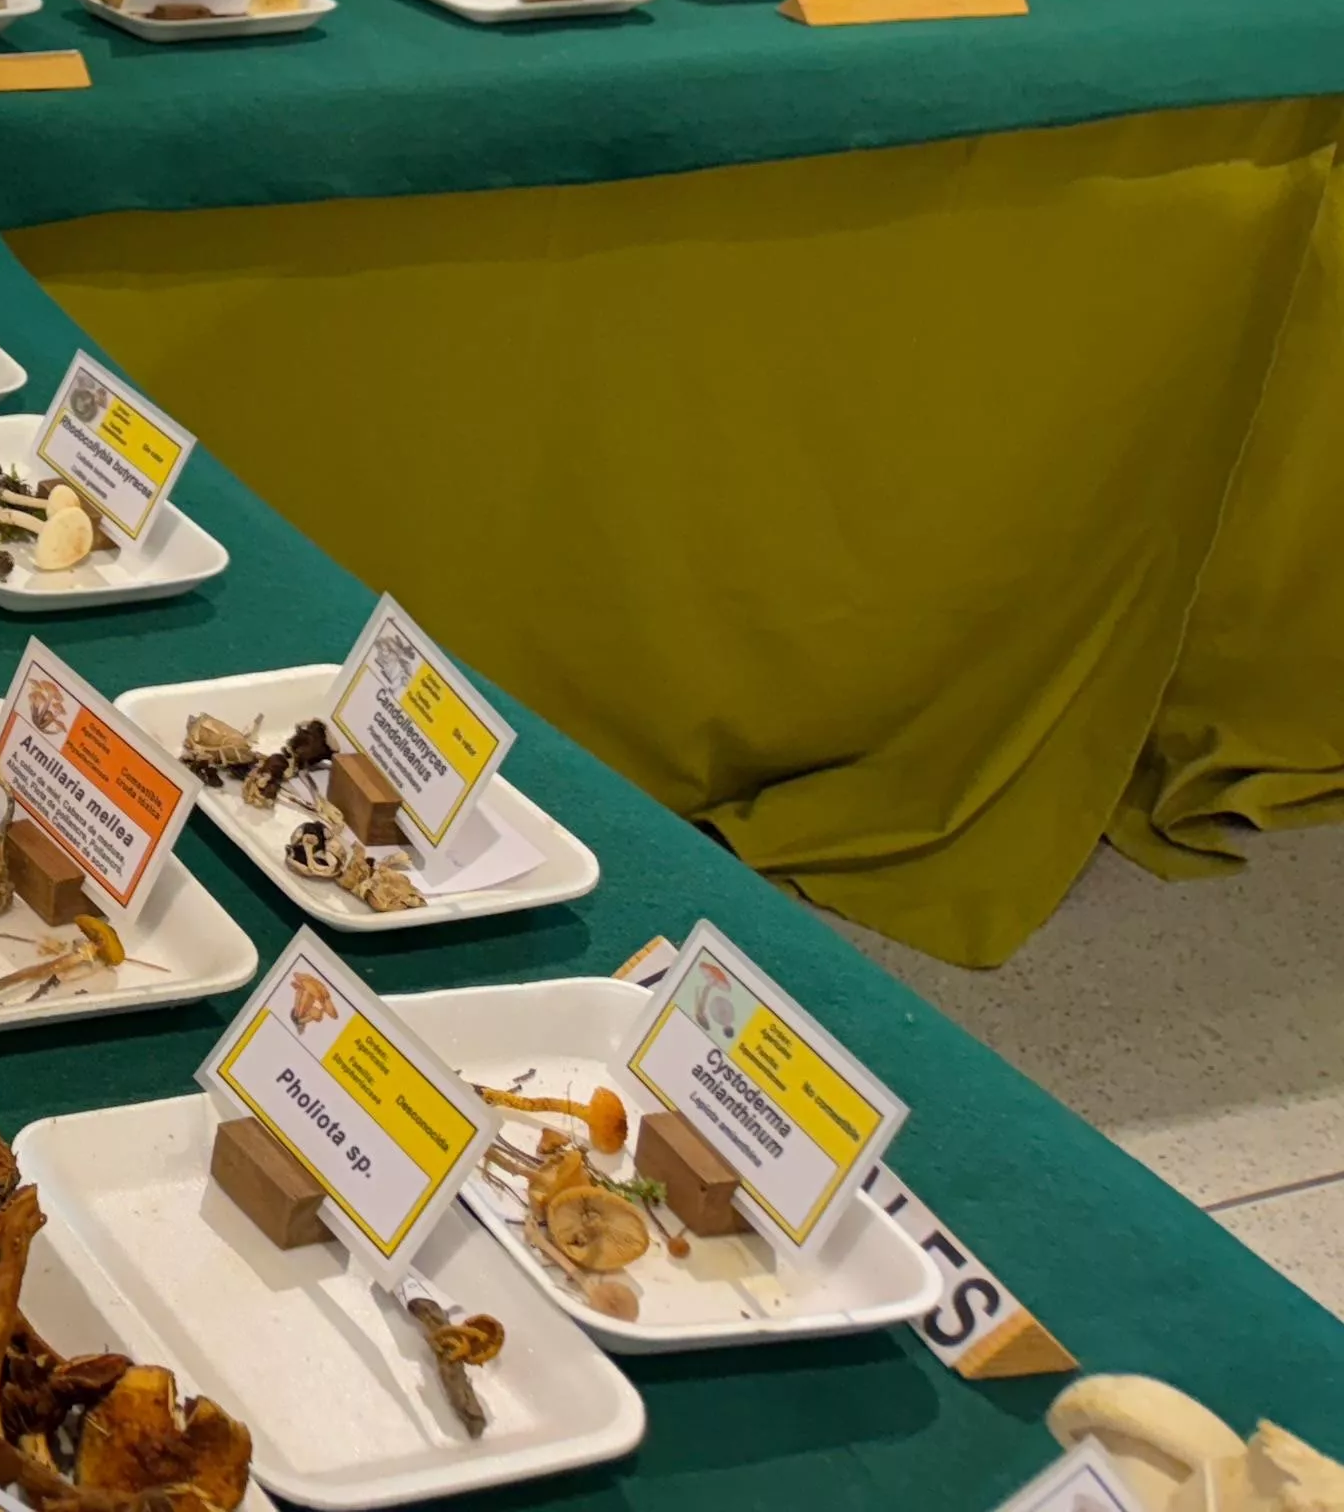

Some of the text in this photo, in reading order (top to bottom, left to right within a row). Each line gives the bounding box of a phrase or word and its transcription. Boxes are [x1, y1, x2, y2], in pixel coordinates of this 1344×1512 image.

[59, 413, 113, 466] Rhodocollybia
[111, 458, 152, 500] butyracea
[372, 711, 431, 784] candolleanus
[374, 685, 447, 777] Candolleomyces
[18, 730, 134, 849] Armillaria mellea
[86, 822, 96, 837] de
[353, 1036, 389, 1076] Agaricales
[705, 1045, 791, 1139] Cystoderma
[275, 1065, 377, 1179] Pholiota sp.
[394, 1093, 450, 1154] Desconocida
[689, 1064, 782, 1160] amianthinum
[800, 1080, 860, 1143] No comestible
